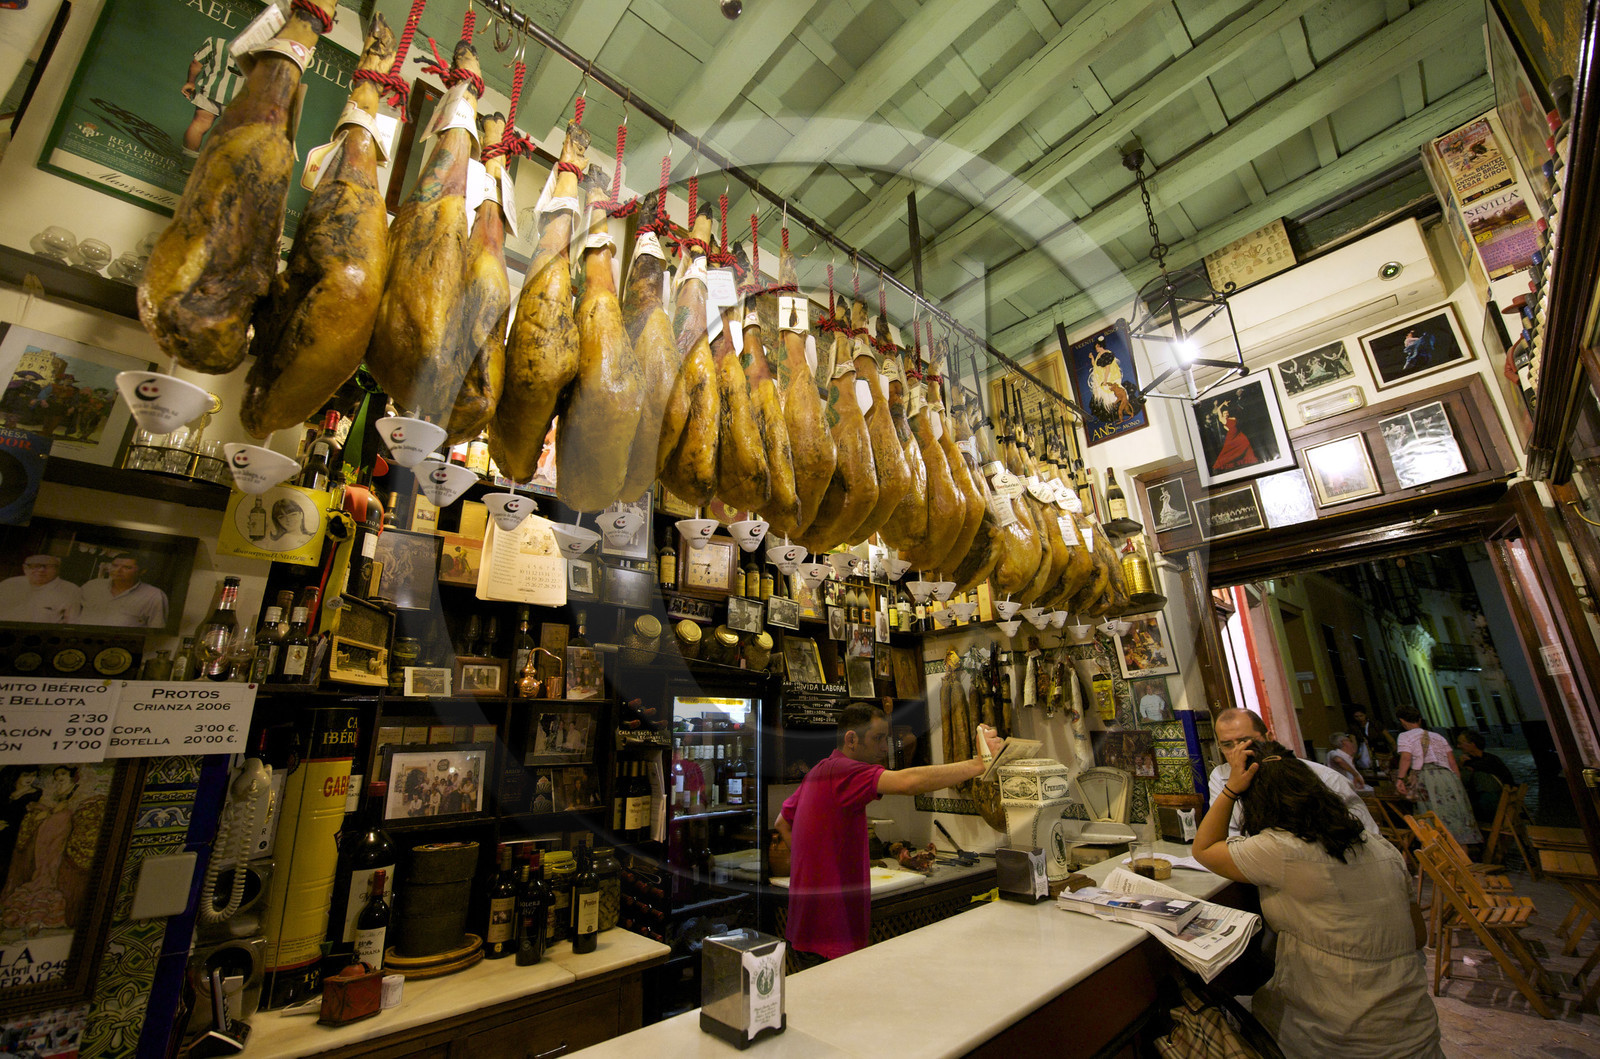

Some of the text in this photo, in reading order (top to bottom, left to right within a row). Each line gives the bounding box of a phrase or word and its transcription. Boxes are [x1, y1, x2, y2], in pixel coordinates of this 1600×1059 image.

[108, 135, 177, 168] REAL BETIS
[1456, 160, 1506, 188] ANTONIO BRICIO
[91, 172, 176, 206] Manzanilla
[1466, 192, 1519, 218] SEVILLA
[1122, 420, 1140, 431] MONO
[42, 682, 108, 693] IBÉRICO
[801, 683, 819, 691] VIDA
[821, 684, 847, 692] LABORAL
[151, 688, 220, 699] PROTOS
[9, 696, 87, 706] BELLOTA
[133, 702, 231, 711] CRIANZA 2006
[112, 725, 152, 735] COPA
[110, 737, 170, 747] BOTELLA
